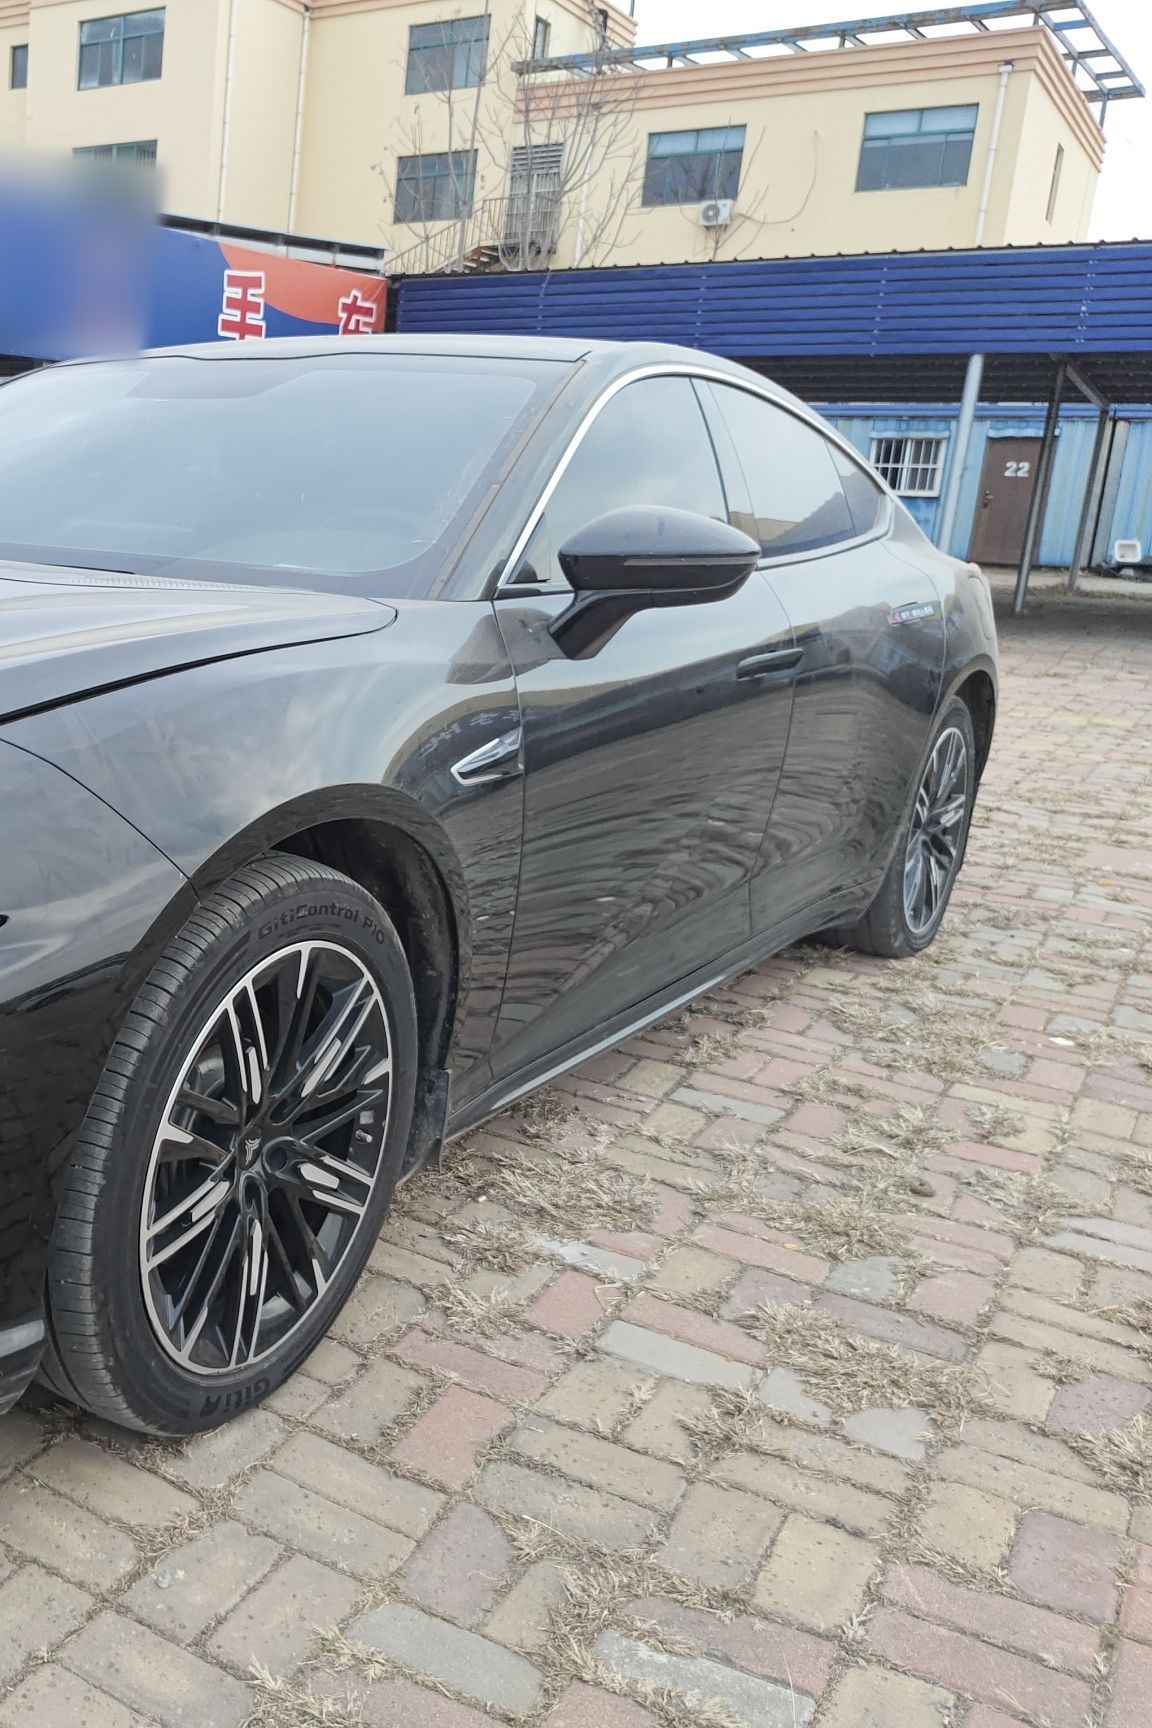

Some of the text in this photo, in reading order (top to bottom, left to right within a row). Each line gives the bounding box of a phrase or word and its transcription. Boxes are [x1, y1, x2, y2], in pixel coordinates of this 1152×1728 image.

[1004, 461, 1030, 477] 22
[258, 902, 385, 945] GitiControl P10
